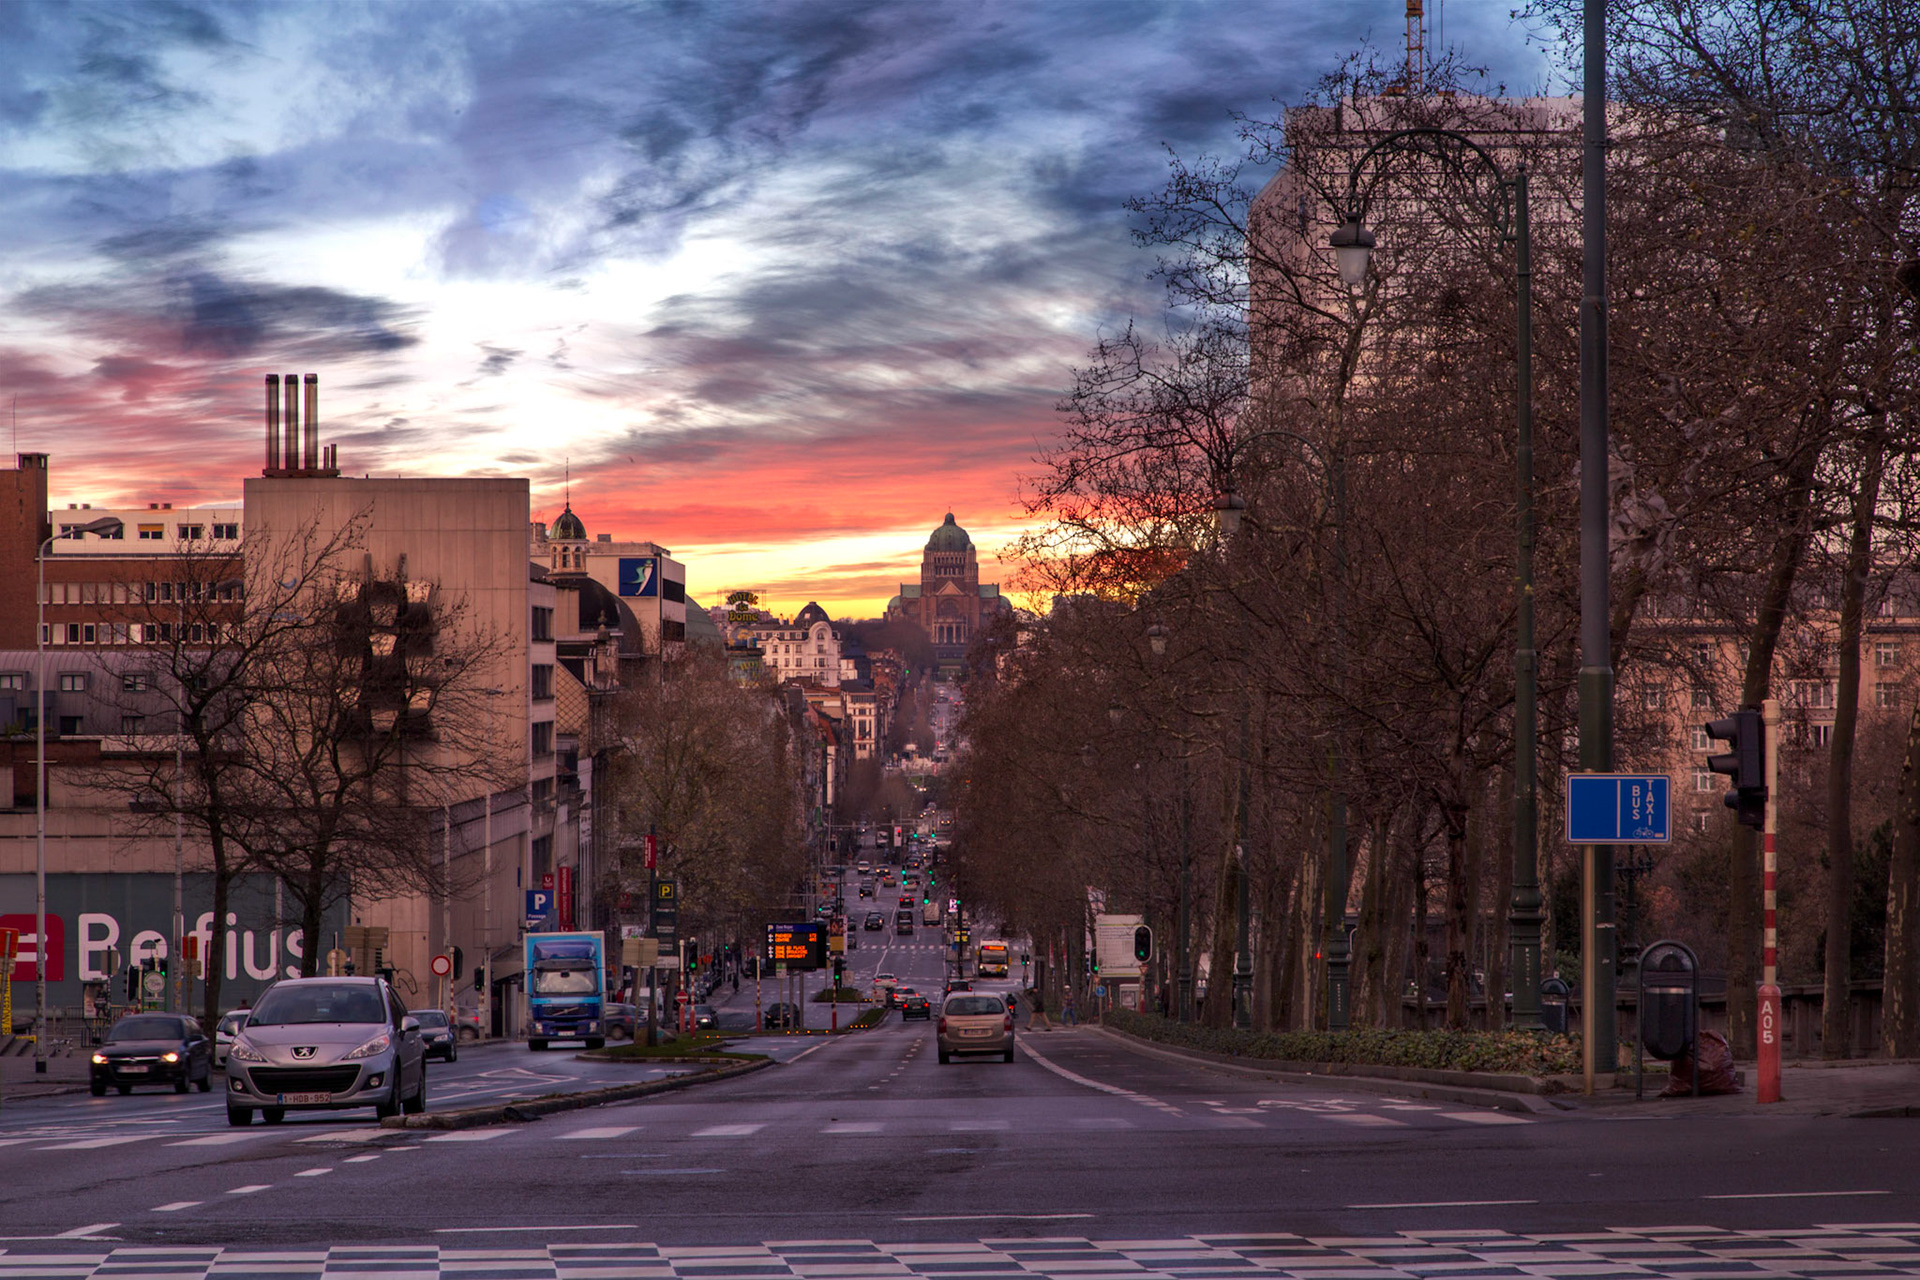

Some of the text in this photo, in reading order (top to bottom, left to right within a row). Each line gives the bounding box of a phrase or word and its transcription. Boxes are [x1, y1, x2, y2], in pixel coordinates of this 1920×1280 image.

[727, 591, 759, 606] HOTEL
[1632, 785, 1640, 820] BUS
[1646, 780, 1654, 826] TAXI
[534, 893, 546, 910] P
[662, 885, 670, 896] P
[78, 912, 319, 981] Befius
[1761, 1000, 1773, 1044] A05
[283, 1094, 330, 1103] 1-HDB-952
